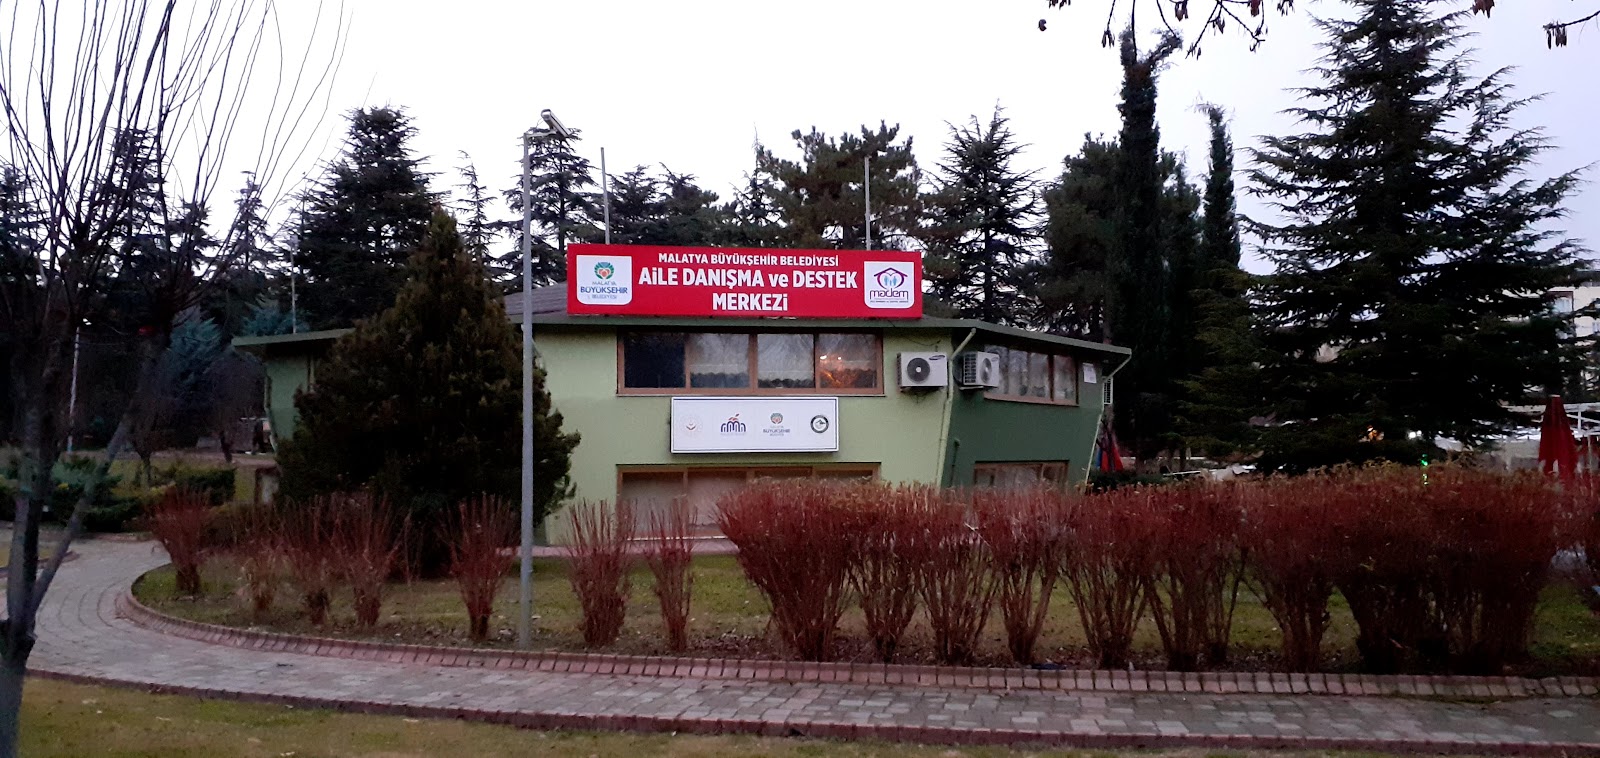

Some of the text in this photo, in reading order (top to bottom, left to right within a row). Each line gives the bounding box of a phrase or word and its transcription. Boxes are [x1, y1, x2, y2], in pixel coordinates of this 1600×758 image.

[658, 252, 839, 267] MALATYA BÜYÜKŞEHİR BELEDİYESİ
[682, 268, 765, 289] DANIŞMA
[768, 273, 789, 288] ve
[793, 270, 858, 289] DESTEK
